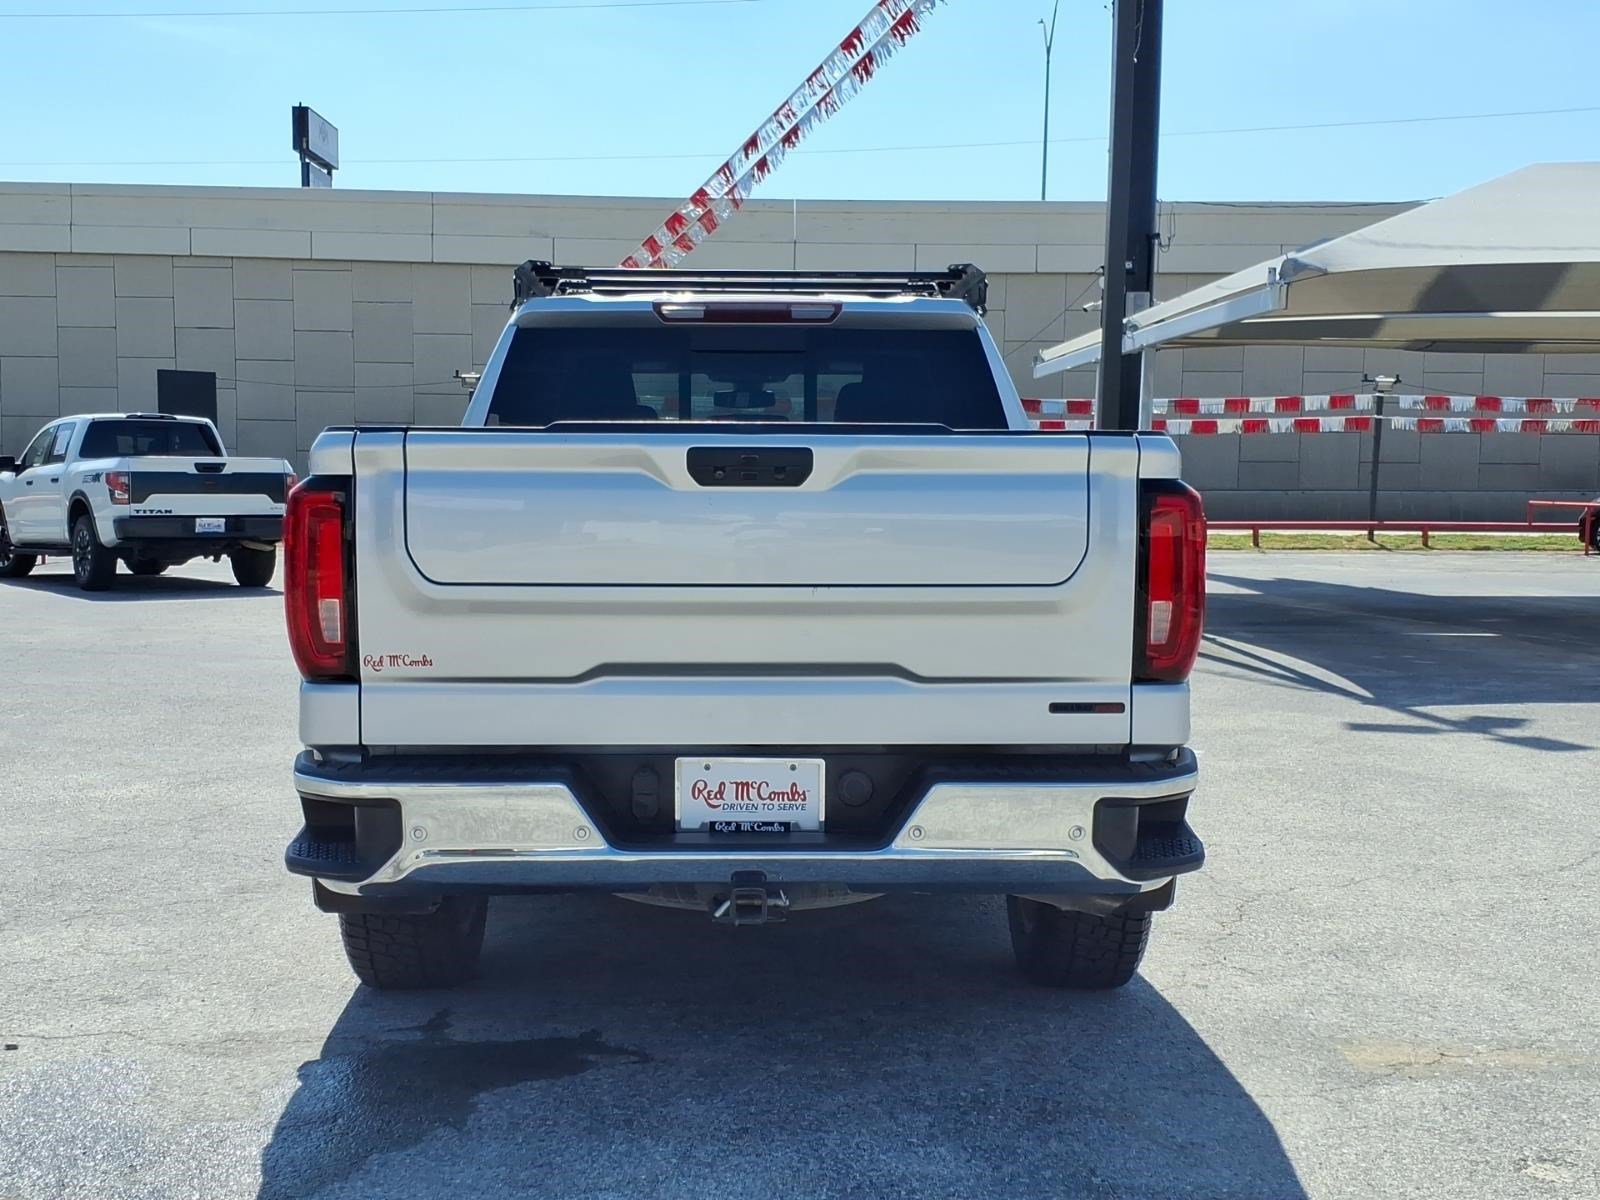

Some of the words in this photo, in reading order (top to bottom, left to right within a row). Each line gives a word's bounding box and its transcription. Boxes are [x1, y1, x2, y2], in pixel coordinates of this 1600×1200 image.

[363, 654, 385, 672] Red
[386, 654, 433, 667] McCombs
[691, 779, 726, 809] Red
[729, 781, 807, 802] McCombs
[722, 803, 758, 811] DRIVEN
[762, 803, 774, 811] TO
[777, 803, 807, 811] SERVE
[715, 822, 736, 832] Red
[739, 822, 784, 832] McCombs
